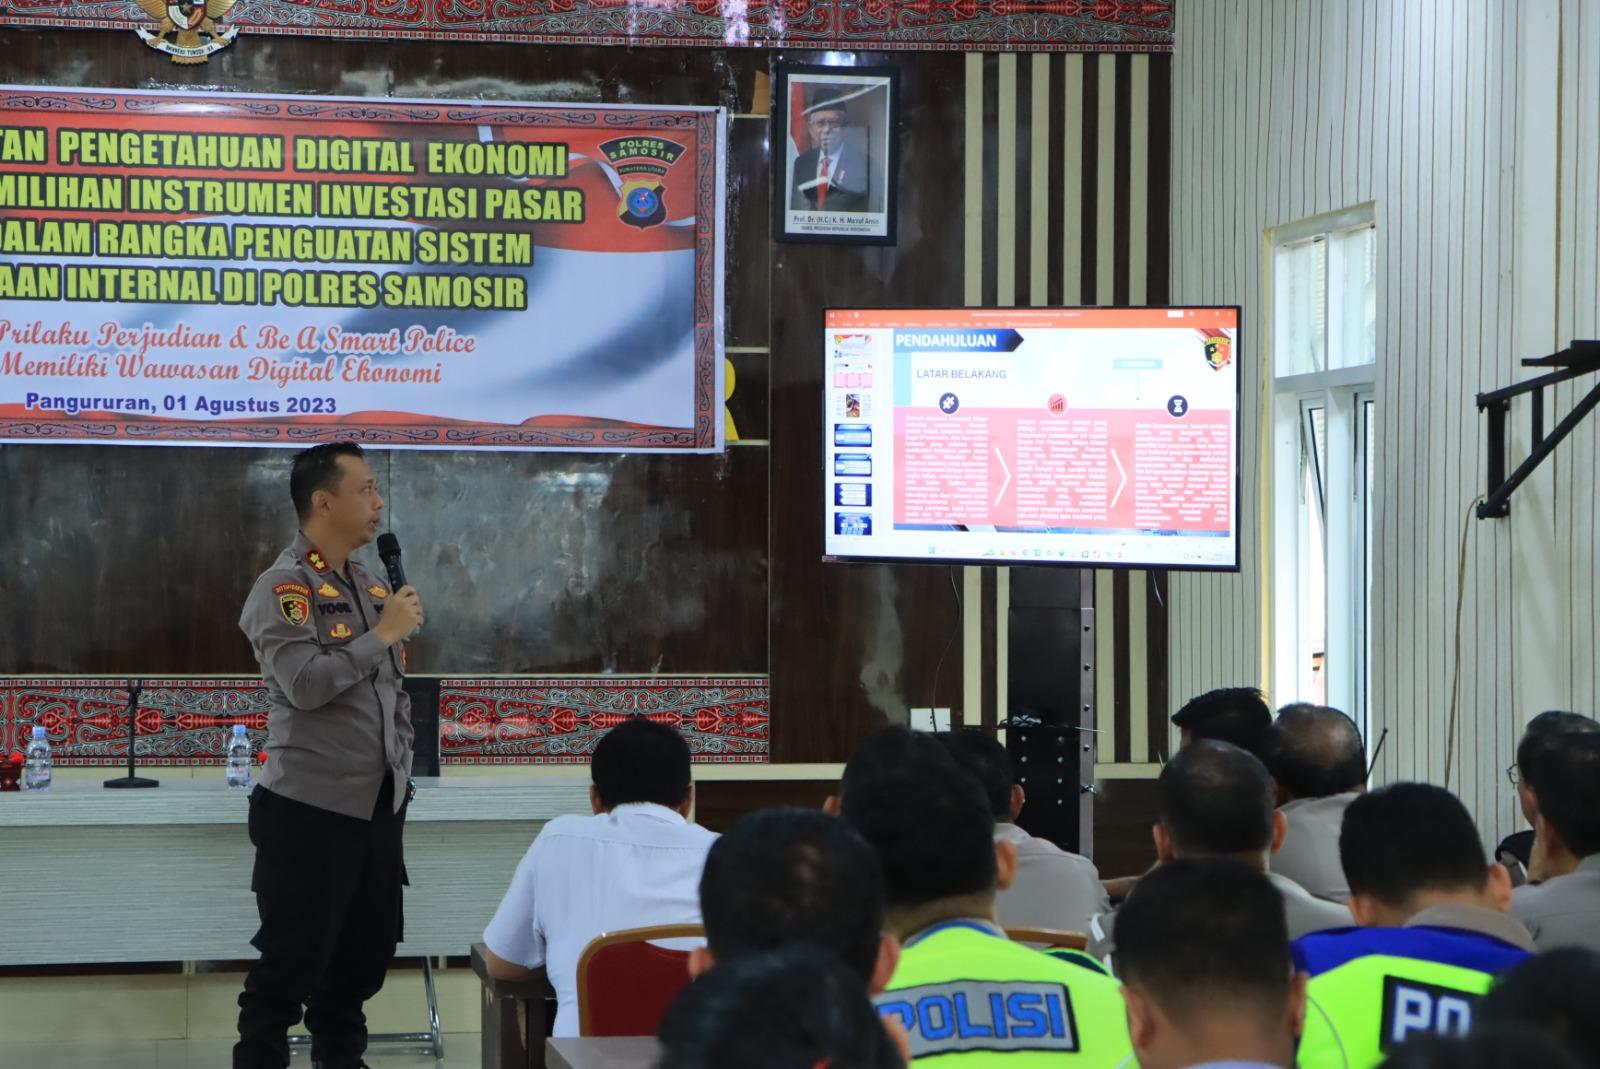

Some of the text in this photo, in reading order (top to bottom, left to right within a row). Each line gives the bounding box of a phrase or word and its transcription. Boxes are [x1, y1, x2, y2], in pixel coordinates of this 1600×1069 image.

[0, 129, 566, 177] AN PENGETAHUAN DIGITAL EKONOMI
[609, 147, 674, 161] SAMOSIR
[619, 140, 665, 149] POLRES
[130, 178, 312, 215] INSTRUMEN
[321, 184, 477, 219] INVESTASI
[485, 187, 583, 221] PASAR
[0, 220, 531, 264] ALAM RANGKA PENGUATAN SISTEM
[67, 267, 216, 302] INTERNAL
[223, 271, 255, 303] DI
[264, 272, 377, 305] POLRES
[384, 274, 526, 308] SAMOSIR
[96, 321, 221, 353] Perjudian
[229, 325, 249, 348] &
[256, 325, 289, 350] Be
[296, 326, 317, 350] A
[322, 327, 399, 351] Smart
[403, 327, 476, 352] Police
[895, 333, 997, 347] PENDAHULUAN
[0, 351, 442, 388] Memiliki Wawasan Digital Ekonomi
[916, 369, 1007, 379] LATAR BELAKANG
[26, 392, 337, 415] Pangururan, 01 Agustus 2023
